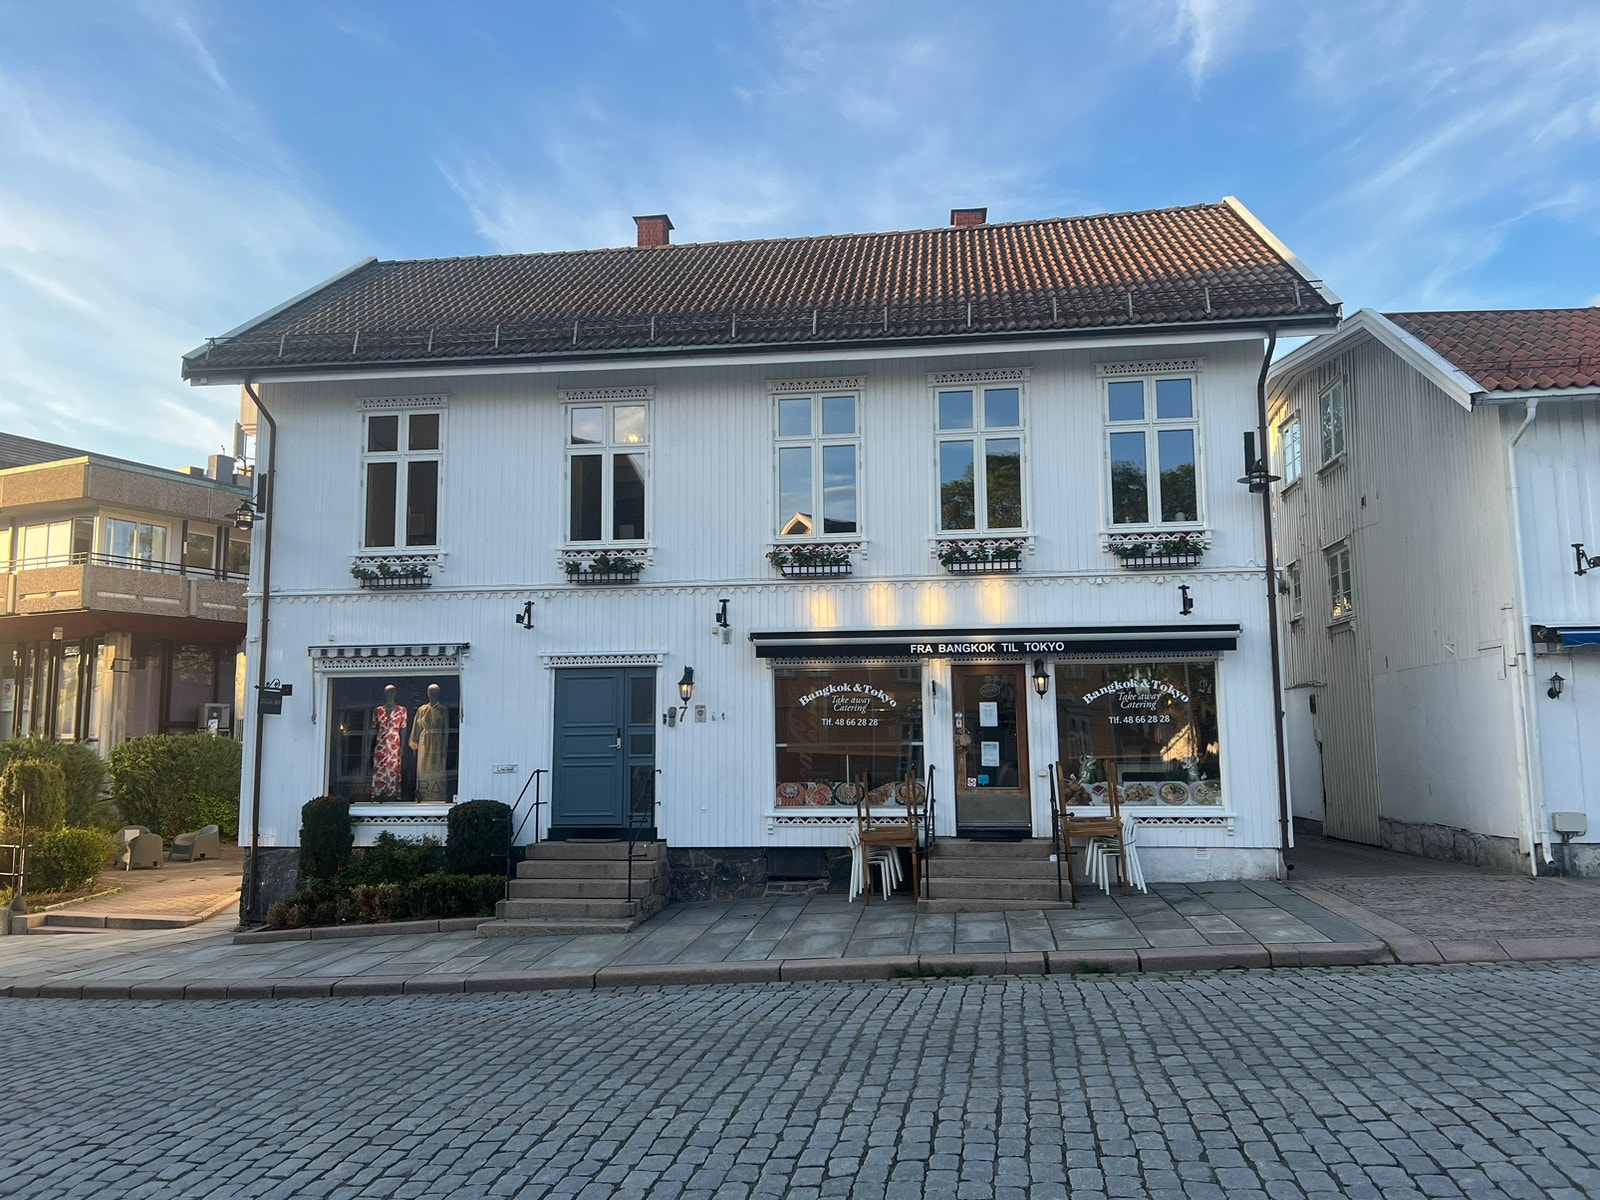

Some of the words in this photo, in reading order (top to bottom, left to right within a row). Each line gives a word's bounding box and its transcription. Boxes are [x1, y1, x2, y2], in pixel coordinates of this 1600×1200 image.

[910, 644, 933, 654] FRA
[938, 643, 996, 653] BANGKOK
[1001, 643, 1019, 652] TIL
[1024, 642, 1065, 652] TOKYO
[798, 683, 852, 706] Bangkok
[863, 684, 897, 707] Tokyo
[1082, 678, 1139, 705] Bangkok
[1151, 680, 1190, 702] Tokyo
[832, 695, 848, 704] Take
[850, 697, 872, 706] away
[1118, 692, 1136, 702] Take
[1138, 694, 1161, 703] away
[834, 704, 868, 714] Catering
[1120, 700, 1157, 710] Catering
[678, 706, 688, 722] 7
[1108, 716, 1122, 724] Tlf.
